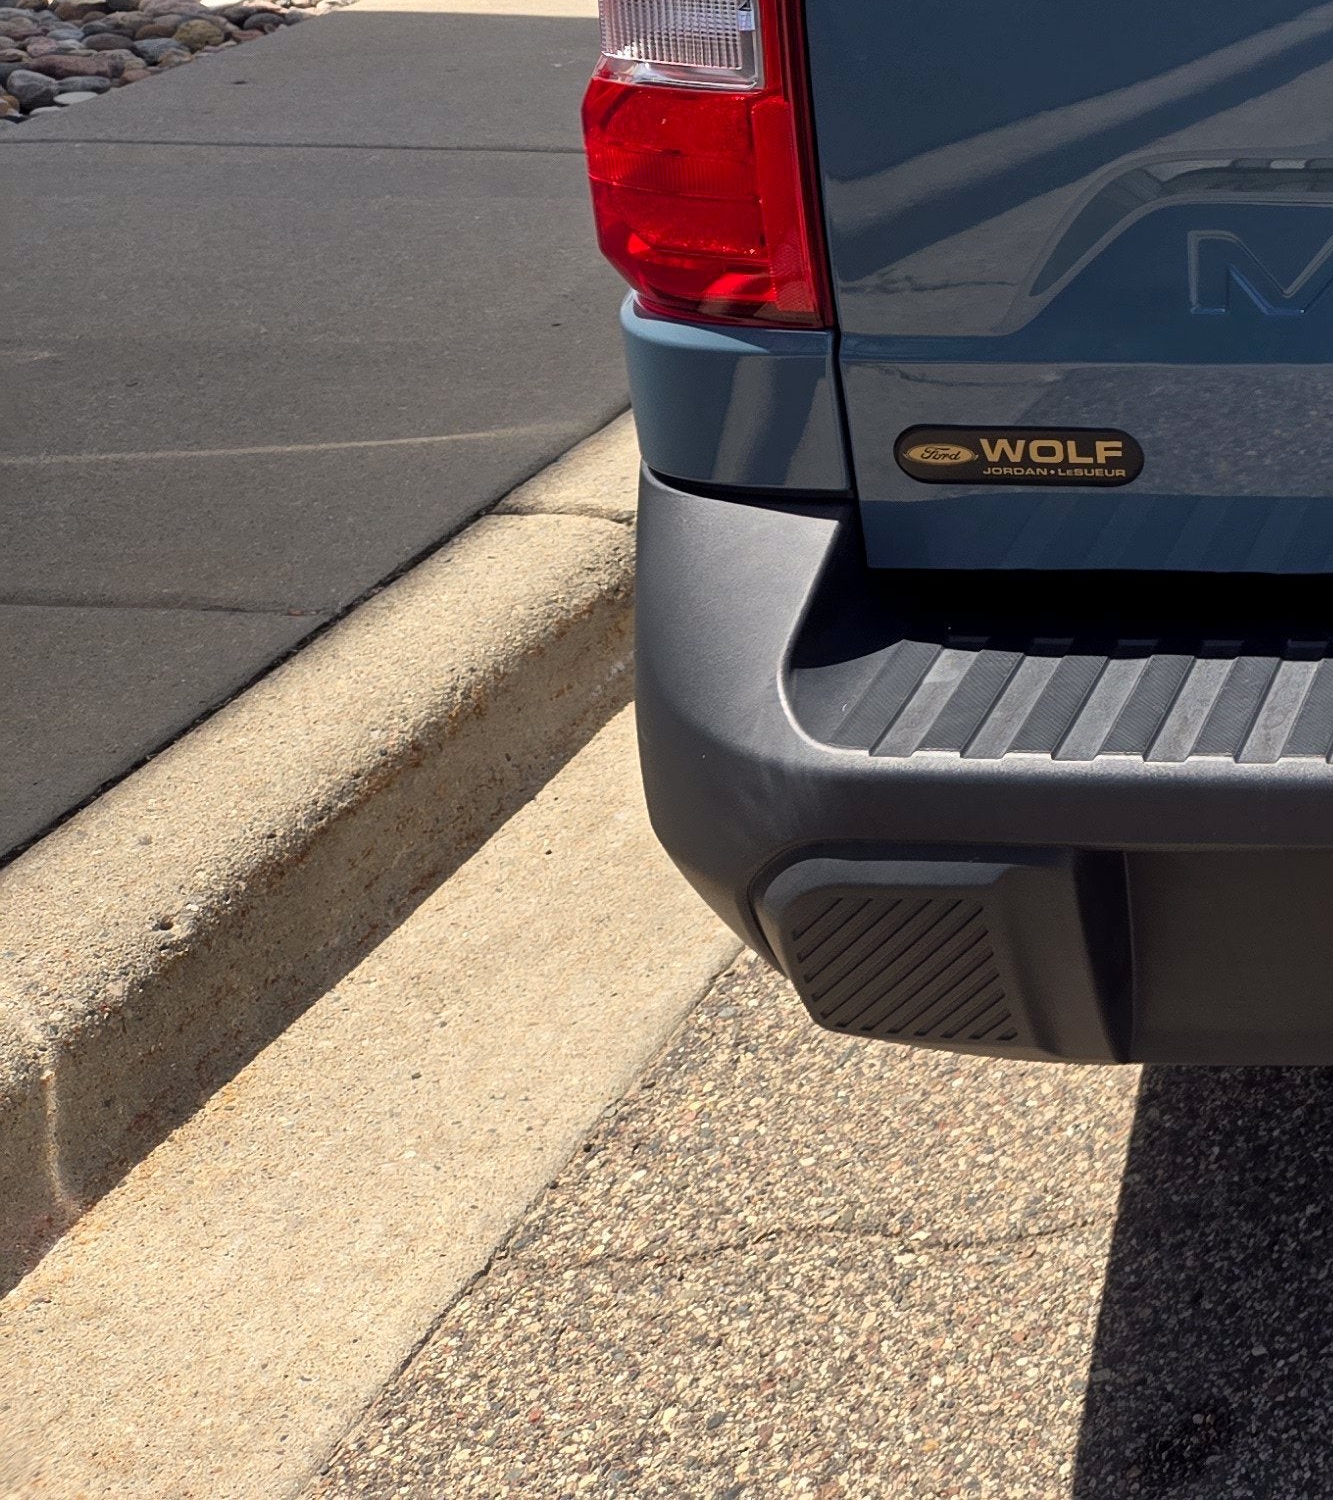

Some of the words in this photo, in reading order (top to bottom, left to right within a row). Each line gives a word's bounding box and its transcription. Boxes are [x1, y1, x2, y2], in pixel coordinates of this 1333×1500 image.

[920, 447, 962, 462] Ford
[979, 437, 1123, 464] WOLF
[983, 466, 1048, 476] JORDAN
